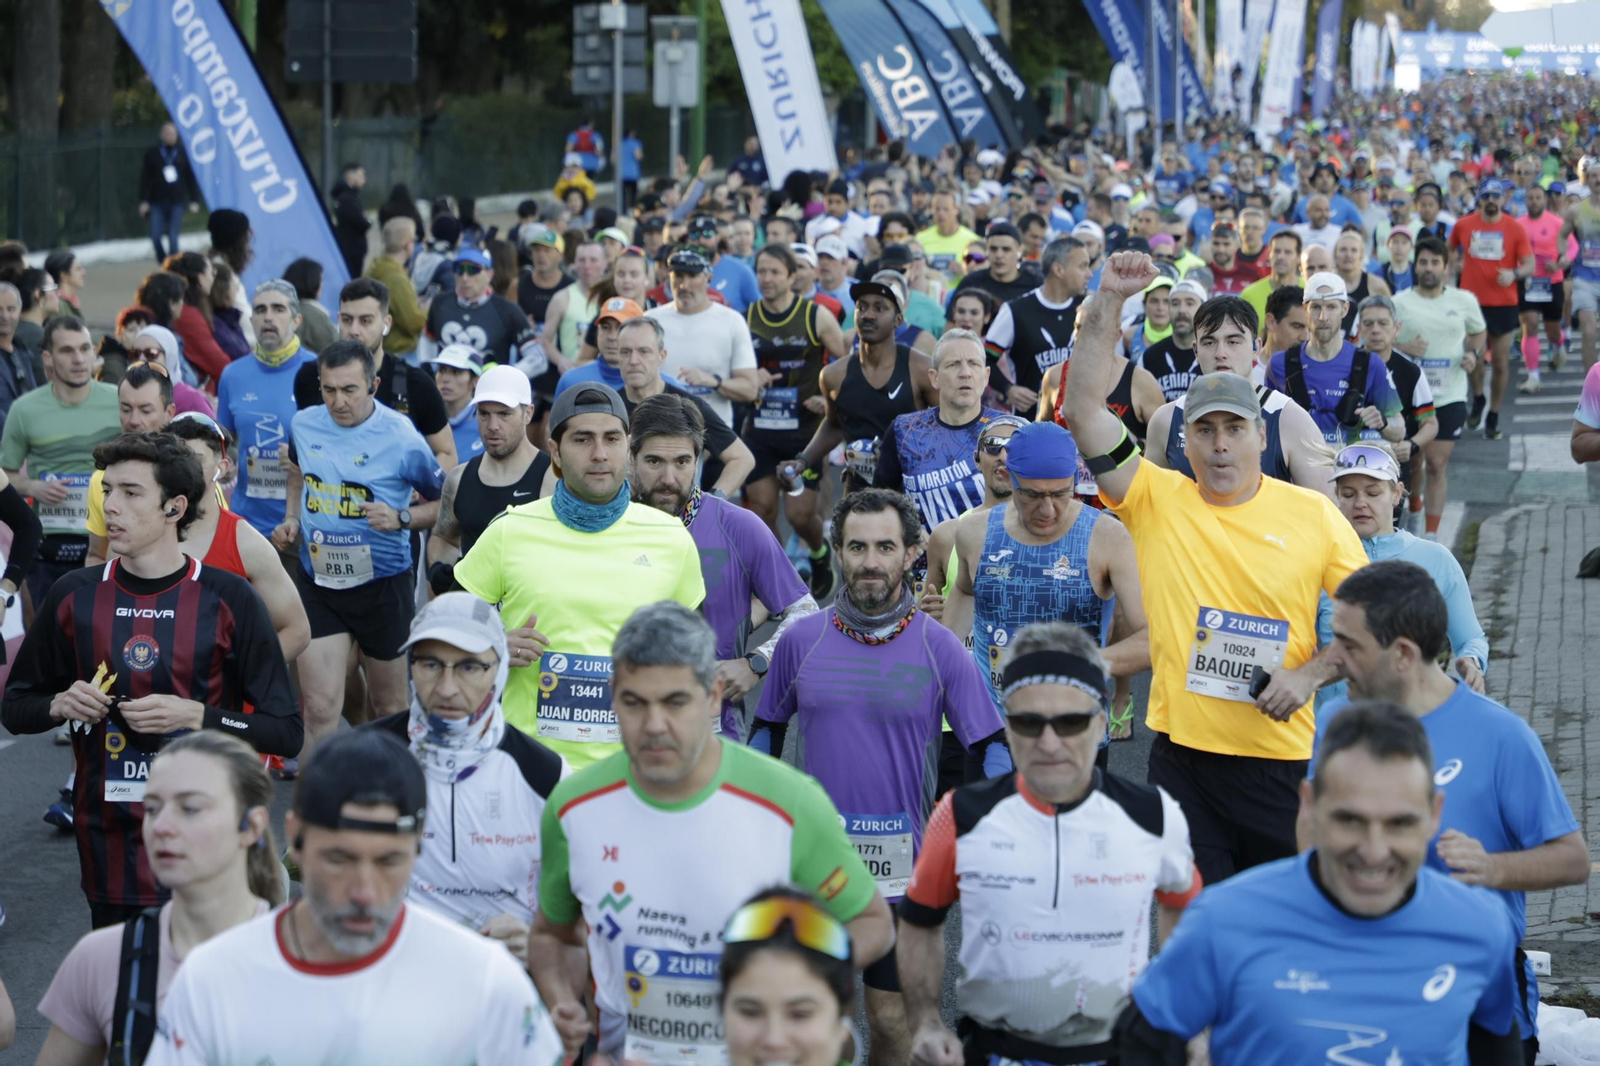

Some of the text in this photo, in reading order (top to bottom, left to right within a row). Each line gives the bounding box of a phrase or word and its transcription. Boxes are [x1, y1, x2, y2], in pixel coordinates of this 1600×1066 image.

[917, 460, 972, 491] MARATÓN
[39, 507, 76, 516] JULIETTE
[326, 534, 361, 544] ZURICH
[327, 552, 349, 560] 11115
[326, 563, 354, 575] P.B.R
[116, 607, 174, 619] GIVOVA
[1228, 618, 1279, 636] ZURICH
[1223, 642, 1256, 658] 10924
[569, 685, 604, 698] 13441
[537, 705, 570, 720] JUAN
[852, 820, 902, 831] ZURICH
[638, 908, 686, 925] Naeva
[638, 926, 698, 949] running
[665, 992, 712, 1009] 10649
